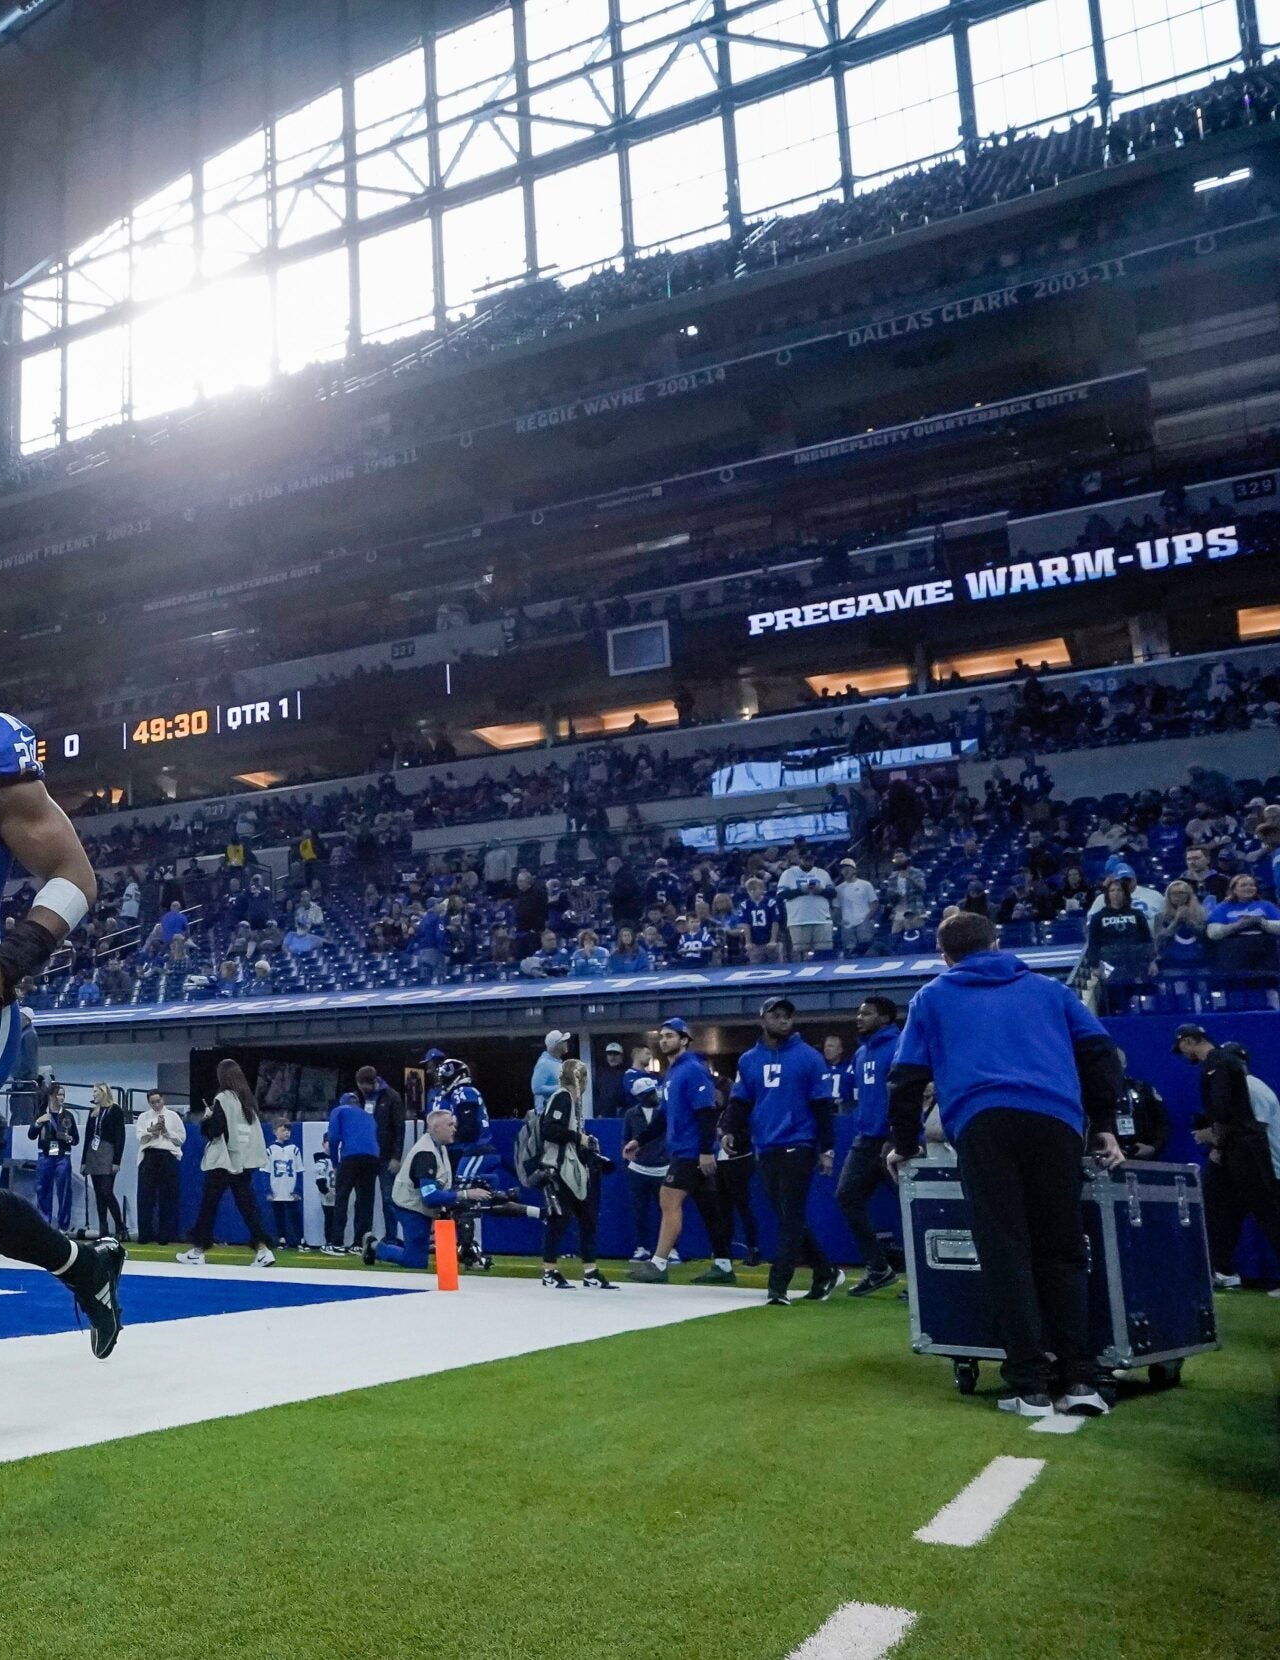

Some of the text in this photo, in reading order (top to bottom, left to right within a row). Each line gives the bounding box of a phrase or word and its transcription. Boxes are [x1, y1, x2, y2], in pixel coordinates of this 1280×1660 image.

[848, 315, 934, 347] DALLAS
[941, 288, 1020, 323] CLARK
[515, 403, 578, 434] REGGIE
[583, 387, 646, 417] WAYNE
[1236, 478, 1273, 496] 329
[748, 525, 1239, 636] PREGAME WARM-UPS
[132, 709, 209, 744] 49:30
[227, 697, 289, 730] QTR 1
[64, 734, 80, 758] 0
[750, 908, 767, 927] 13
[1101, 914, 1137, 928] COLTS
[148, 993, 380, 1016] LUCAS
[384, 985, 524, 1001] OIL
[763, 1063, 782, 1088] C
